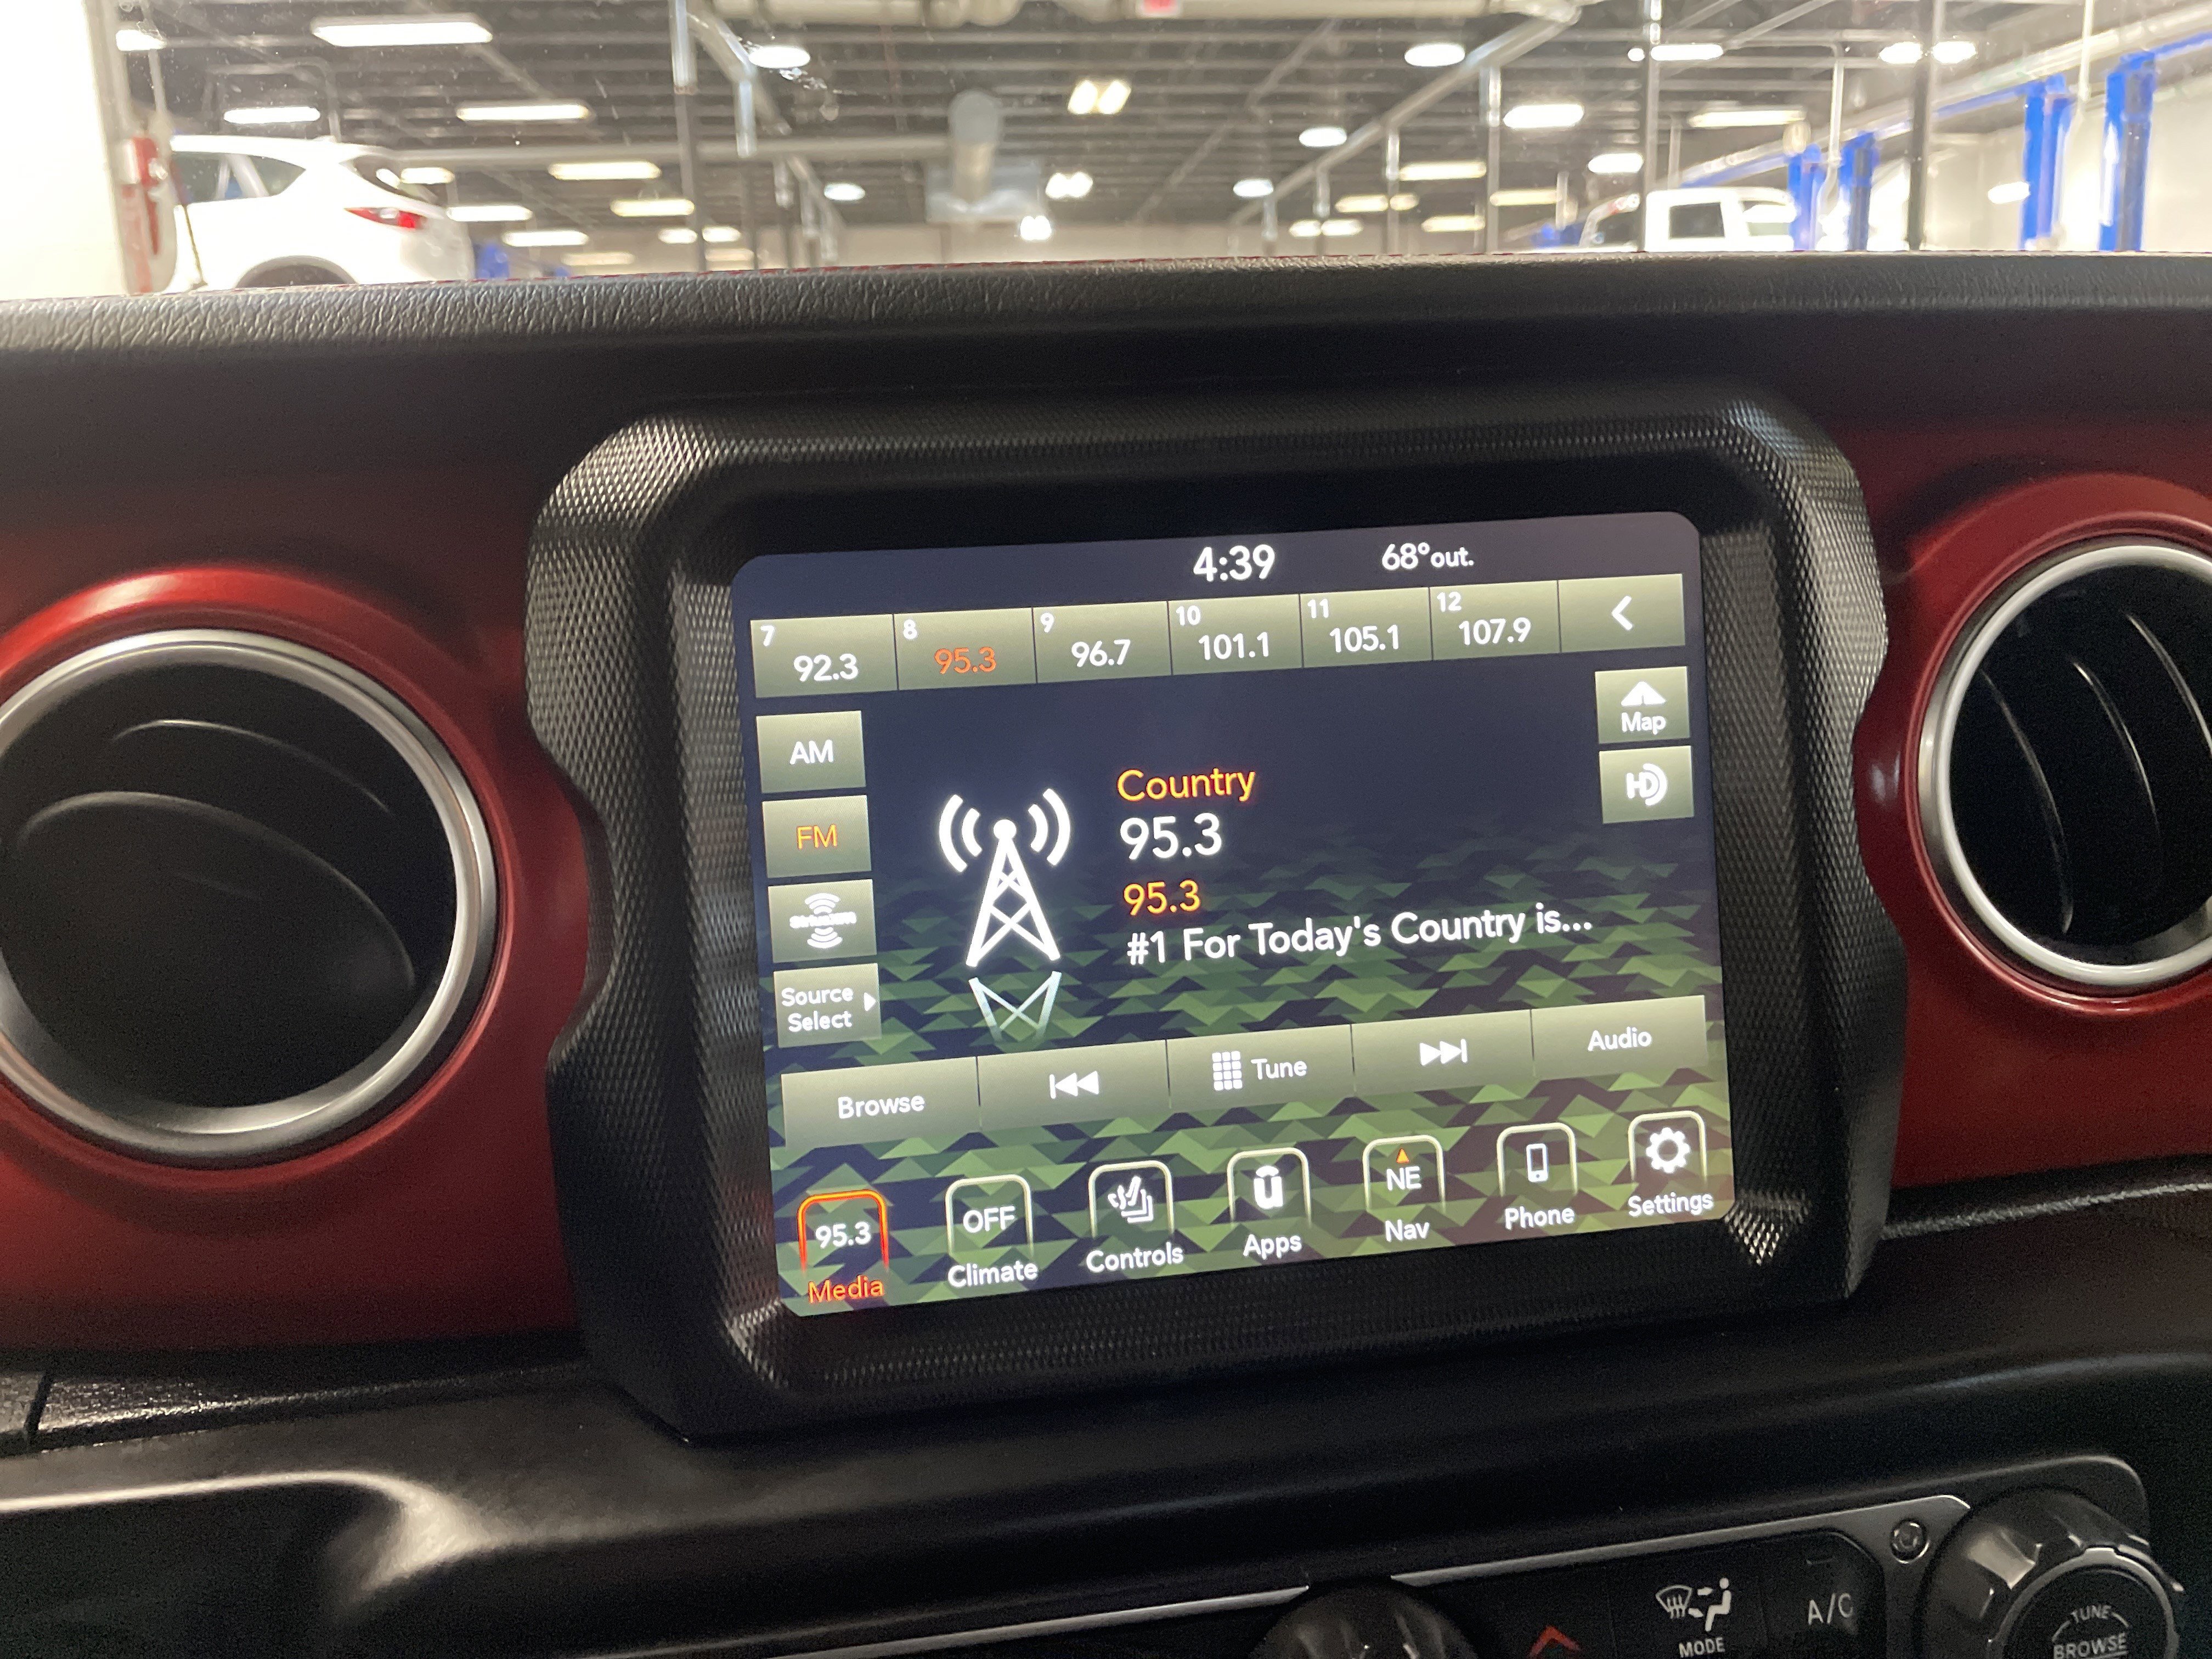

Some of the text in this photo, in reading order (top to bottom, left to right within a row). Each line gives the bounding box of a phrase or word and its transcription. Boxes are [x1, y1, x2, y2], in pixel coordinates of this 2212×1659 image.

[1193, 544, 1275, 582] 4:39
[1307, 599, 1329, 618] 11
[1437, 591, 1462, 612] 12
[1040, 613, 1056, 633] 9
[1176, 605, 1201, 627] 10
[760, 624, 776, 646] 7
[902, 619, 918, 640] 8
[1330, 624, 1398, 652] 105.1
[1458, 617, 1531, 645] 107.9
[1071, 639, 1131, 667] 96.7
[1199, 632, 1268, 660] 101.1
[794, 653, 859, 681] 92.3
[934, 647, 996, 674] 95.3
[1622, 712, 1666, 735] Map
[790, 739, 833, 764] AM
[1117, 768, 1255, 802] Country
[797, 824, 837, 849] FM
[1120, 813, 1222, 860] 95.3
[1124, 879, 1200, 916] 95.3
[1127, 902, 1592, 965] #1 For Today's Country is...
[781, 988, 854, 1006] Source
[788, 1011, 852, 1032] Select
[1588, 1026, 1652, 1051] Audio
[1251, 1058, 1307, 1080] Tune
[838, 1095, 925, 1119] Browse
[1386, 1166, 1421, 1191] NE
[1628, 1192, 1714, 1217] Settings
[963, 1206, 1015, 1233] OFF
[1385, 1219, 1429, 1242] Nav
[1505, 1206, 1575, 1230] Phone
[815, 1221, 872, 1249] 95.3
[1243, 1234, 1302, 1260] Apps
[1086, 1242, 1184, 1273] Controls
[948, 1260, 1038, 1288] Climate
[808, 1276, 884, 1304] Media
[1808, 1592, 1854, 1626] A/C
[2071, 1604, 2112, 1624] TUNE
[1679, 1638, 1725, 1658] MODE
[2053, 1633, 2127, 1659] BROWSE
